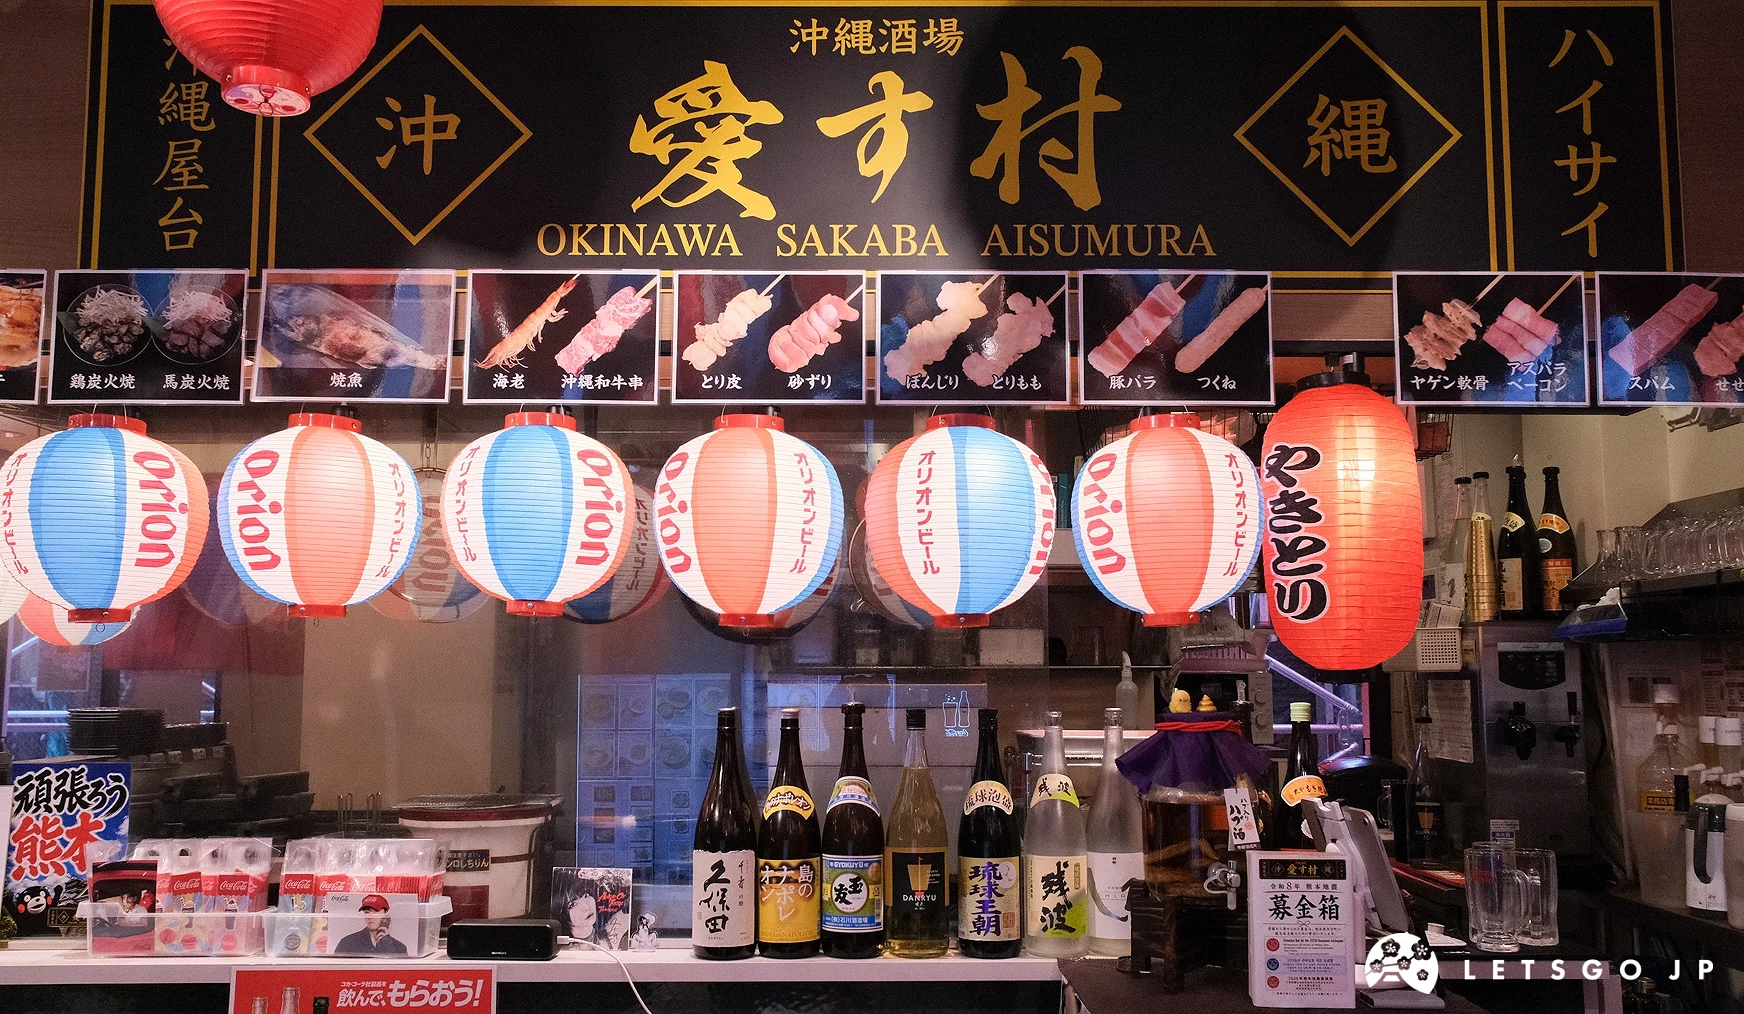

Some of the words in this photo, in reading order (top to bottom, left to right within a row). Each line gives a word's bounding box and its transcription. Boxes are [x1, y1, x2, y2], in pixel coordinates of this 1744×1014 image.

[789, 17, 964, 57] 沖縄酒場
[375, 93, 461, 176] 沖
[629, 45, 1122, 221] 愛す村
[1303, 93, 1398, 177] 縄
[1548, 28, 1617, 259] ハイサイ
[536, 223, 743, 258] OKINAWA
[775, 223, 948, 258] SAKABA
[981, 223, 1216, 258] AISUMURA
[69, 372, 136, 391] 鶏炭火焼
[163, 372, 230, 392] 馬炭火焼
[329, 371, 364, 390] 焼魚
[492, 372, 526, 391] 海老
[560, 372, 644, 392] 沖縄和牛串
[701, 374, 743, 391] とり皮
[787, 373, 832, 391] 砂ずり
[992, 374, 1042, 391] とりもも
[1108, 373, 1156, 391] 豚バラ
[1196, 374, 1236, 391] つくね
[1409, 374, 1490, 392] ヤゲン軟骨
[1505, 361, 1567, 377] アスパラ
[1506, 379, 1568, 393] ベーコン
[1628, 374, 1676, 392] スパム
[133, 451, 189, 568] Orion
[236, 450, 283, 571] Orion
[375, 463, 406, 578] オリオンビール
[455, 445, 482, 562] オリオンビール
[575, 449, 624, 566] Orion
[657, 452, 692, 574] Orion
[789, 452, 817, 574] オリオンビール
[915, 450, 941, 575] オリオンビール
[1083, 452, 1126, 575] Orion
[1223, 453, 1249, 577] オリオンビール
[1264, 443, 1331, 622] やきとり
[13, 768, 127, 819] 頑張ろう
[965, 788, 1012, 811] 琉球泡盛
[11, 814, 104, 880] 熊本
[173, 878, 201, 890] Coca-Cola
[219, 880, 248, 891] Coca-Cola
[285, 879, 312, 890] Coca-Cola
[760, 865, 775, 902] オン
[798, 864, 814, 898] 島の
[1270, 882, 1300, 891] 令和8年
[1306, 883, 1338, 891] 熊本地震
[1287, 863, 1318, 875] 愛す村
[699, 859, 731, 934] 久保田
[775, 865, 795, 922] ナポレ
[969, 861, 1004, 937] 琉球王朝
[1040, 861, 1076, 933] 残波
[1268, 894, 1340, 920] 募金箱
